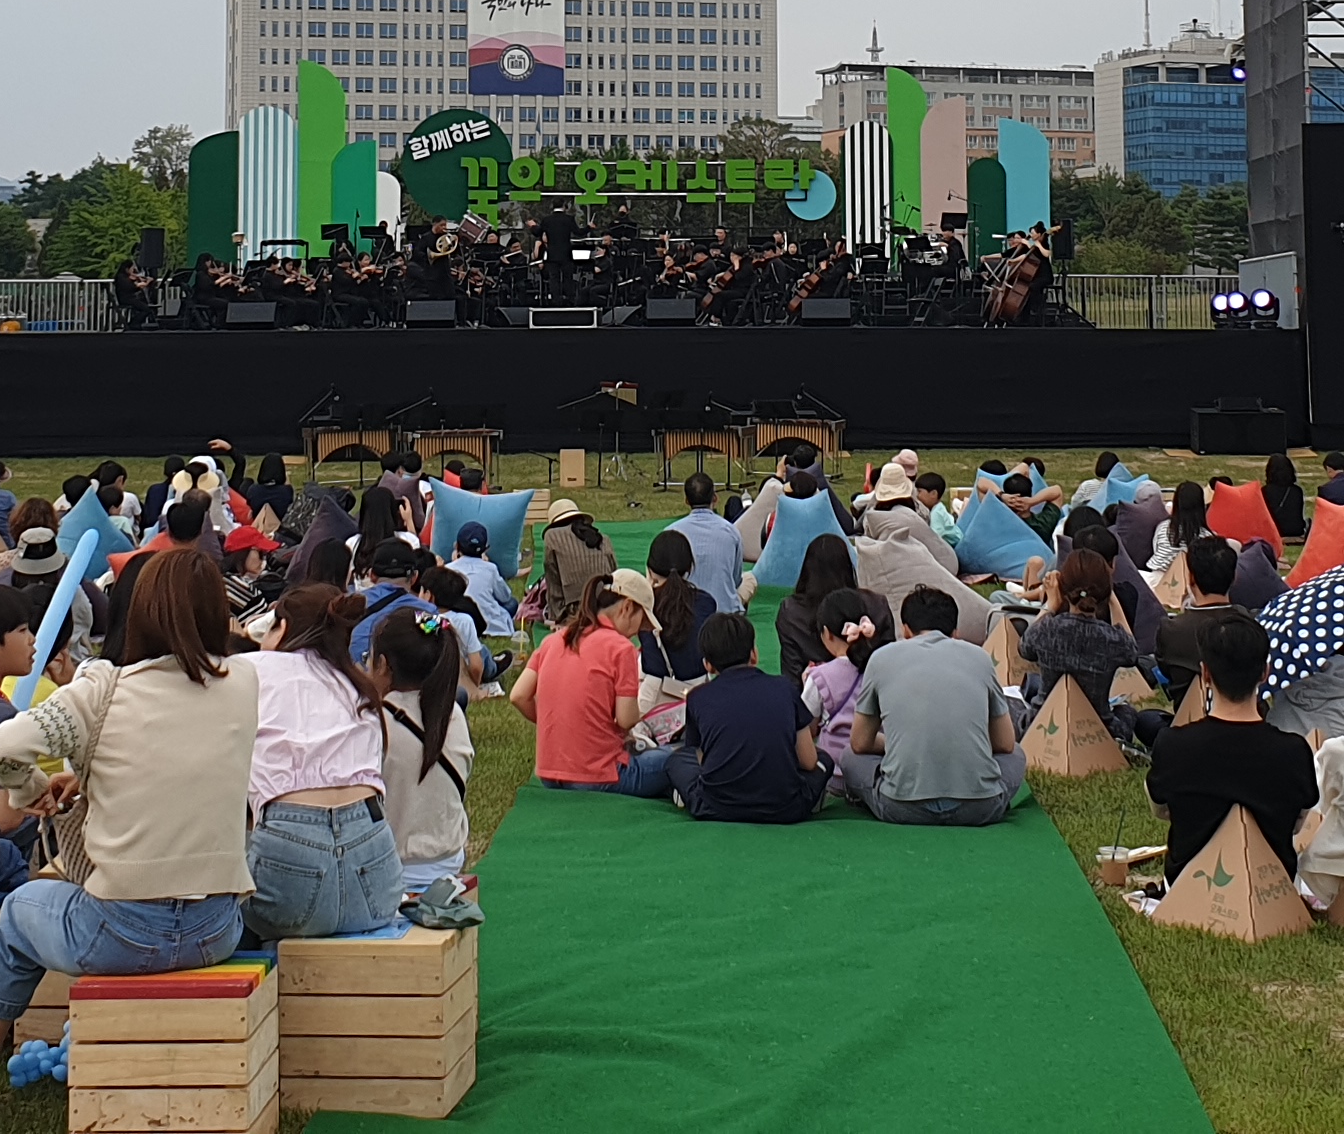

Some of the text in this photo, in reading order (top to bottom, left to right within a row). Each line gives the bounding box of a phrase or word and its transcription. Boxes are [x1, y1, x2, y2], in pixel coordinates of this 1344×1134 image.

[408, 120, 491, 160] 함께하는
[460, 157, 816, 231] 꿈의 오케스트라
